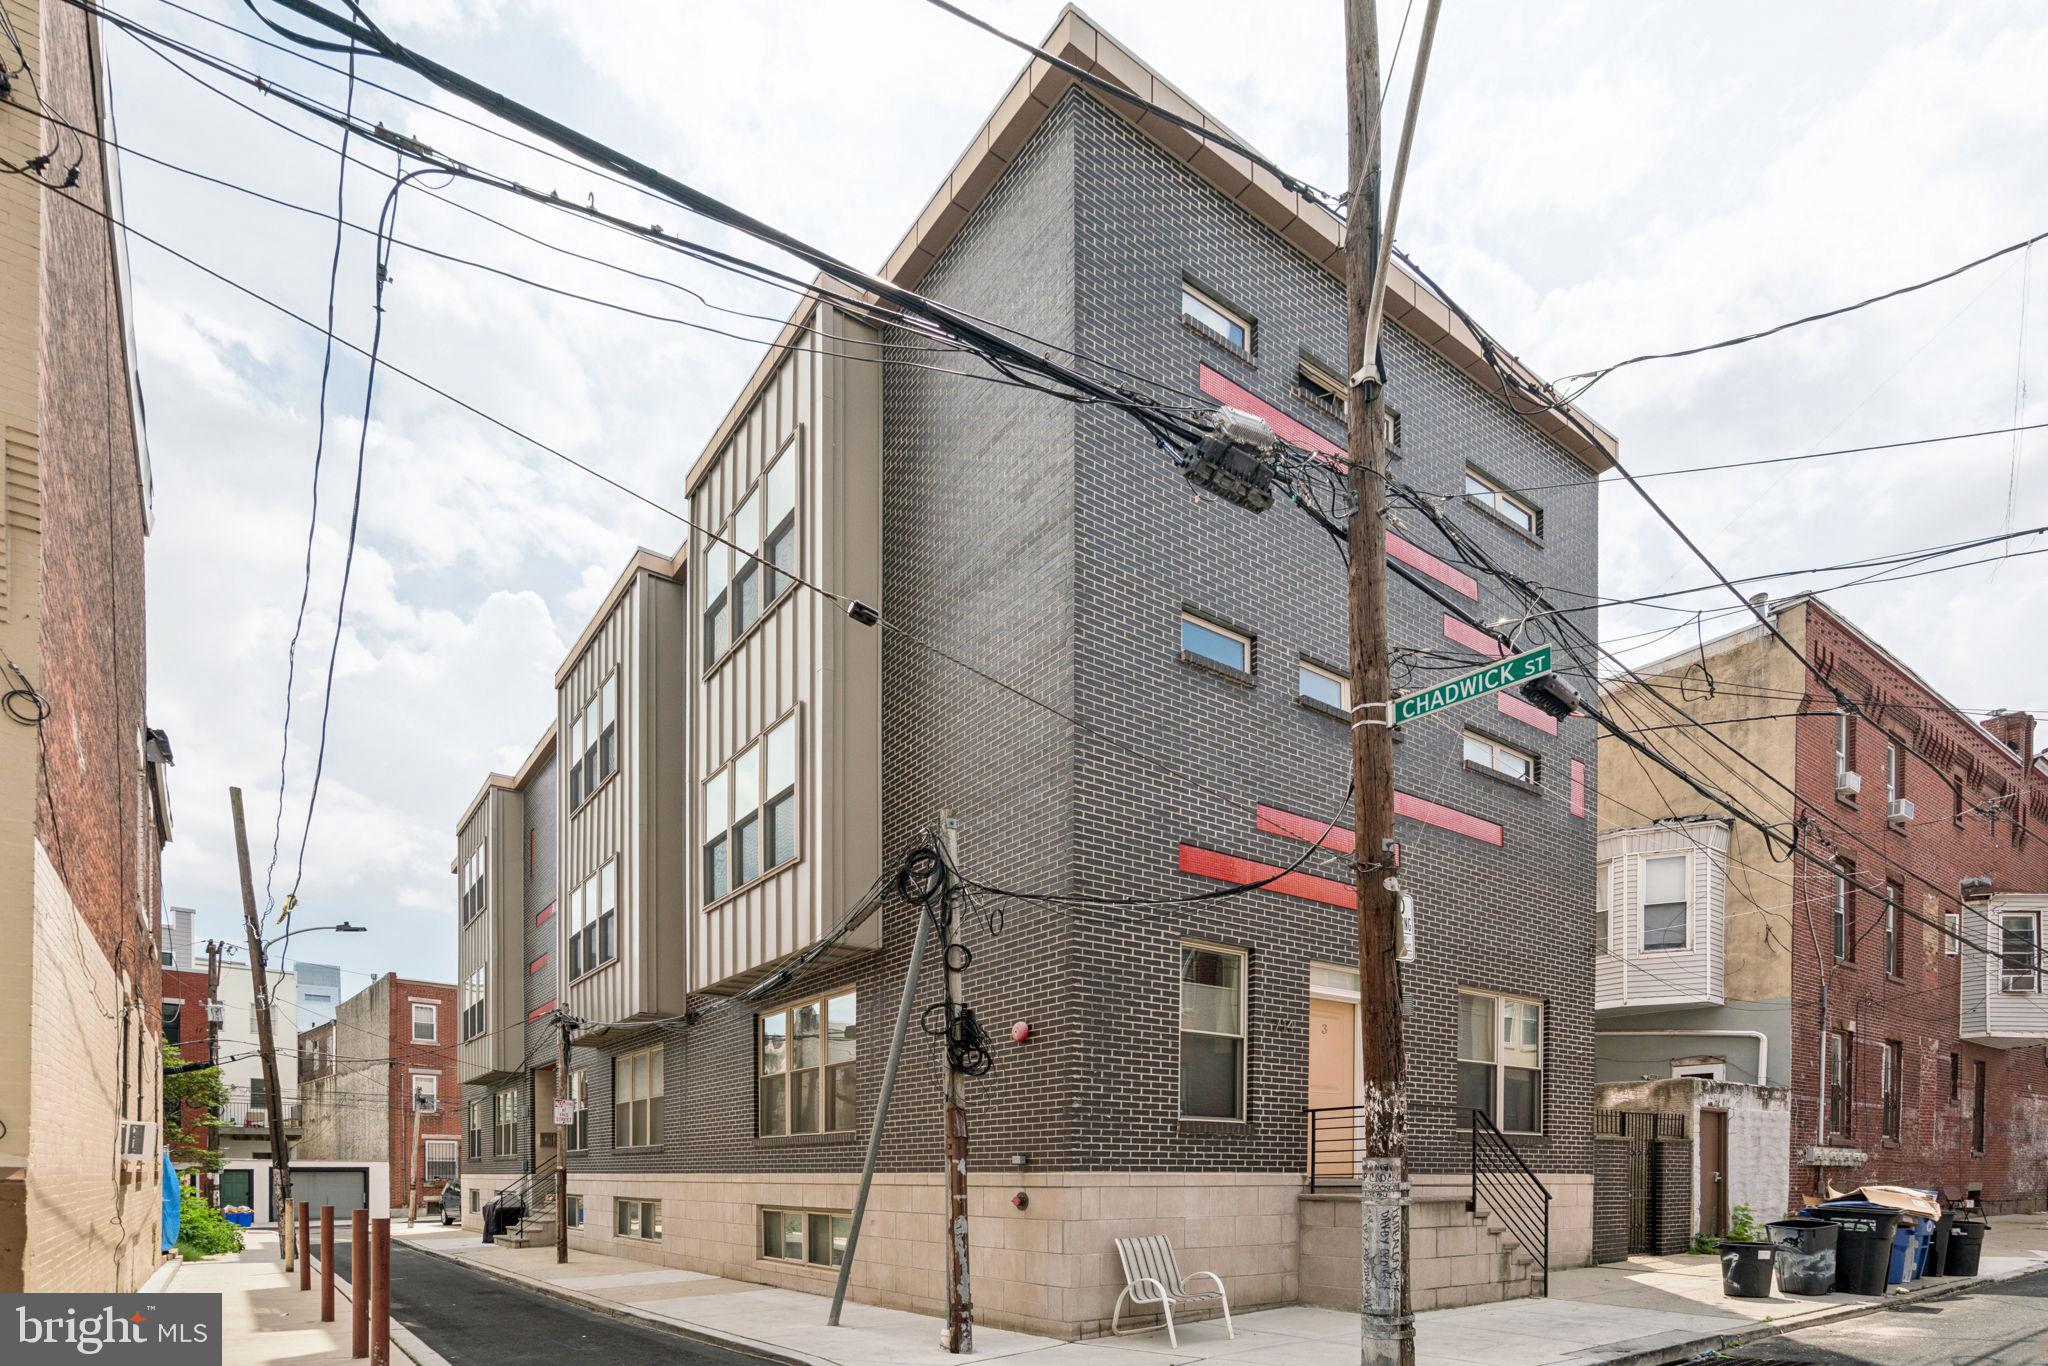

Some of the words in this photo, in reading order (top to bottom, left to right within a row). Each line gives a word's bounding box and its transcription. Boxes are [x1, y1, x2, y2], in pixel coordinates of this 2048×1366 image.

[1402, 663, 1516, 718] CHADWICK
[1524, 655, 1546, 676] ST
[1321, 1024, 1328, 1034] 3
